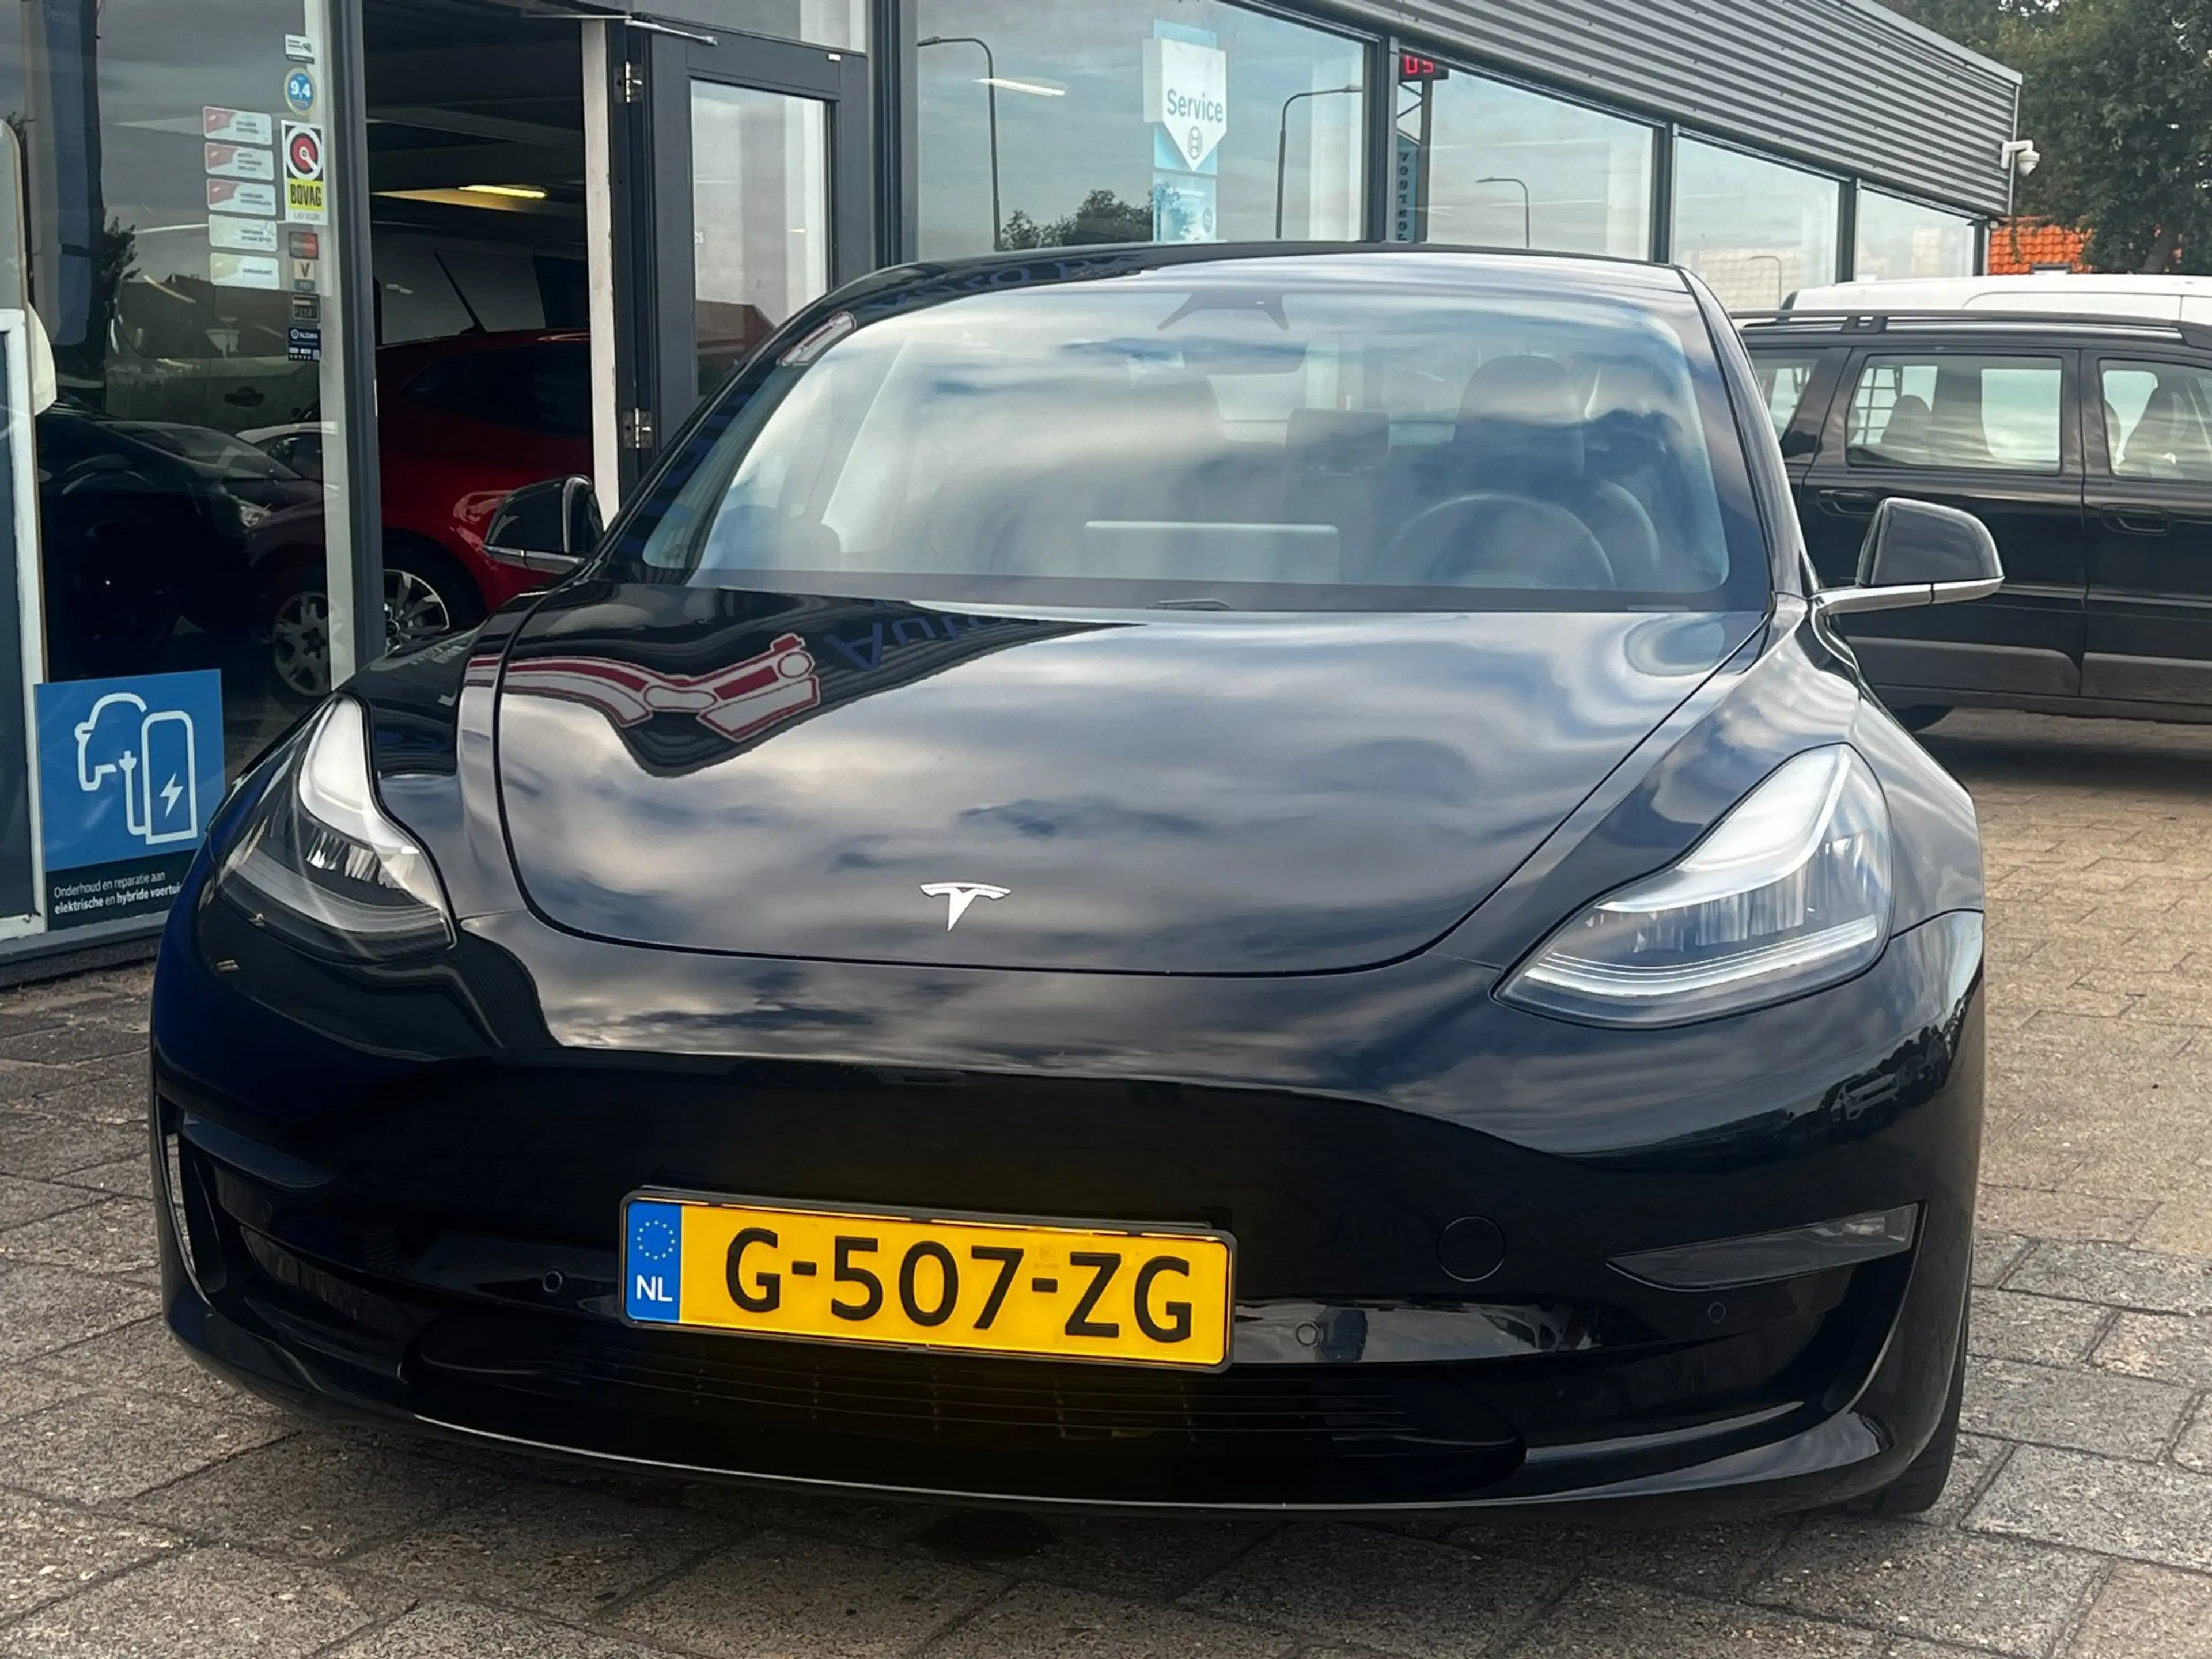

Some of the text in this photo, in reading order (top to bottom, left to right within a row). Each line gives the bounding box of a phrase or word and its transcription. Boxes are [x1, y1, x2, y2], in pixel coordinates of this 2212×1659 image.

[1166, 88, 1224, 124] Service
[290, 184, 322, 207] BOVAG
[54, 871, 166, 899] Onderhoud en reparatie aan
[54, 882, 182, 914] elektrische en hybride voertui
[636, 1274, 673, 1304] NL
[725, 1226, 1193, 1344] G-507-ZG
